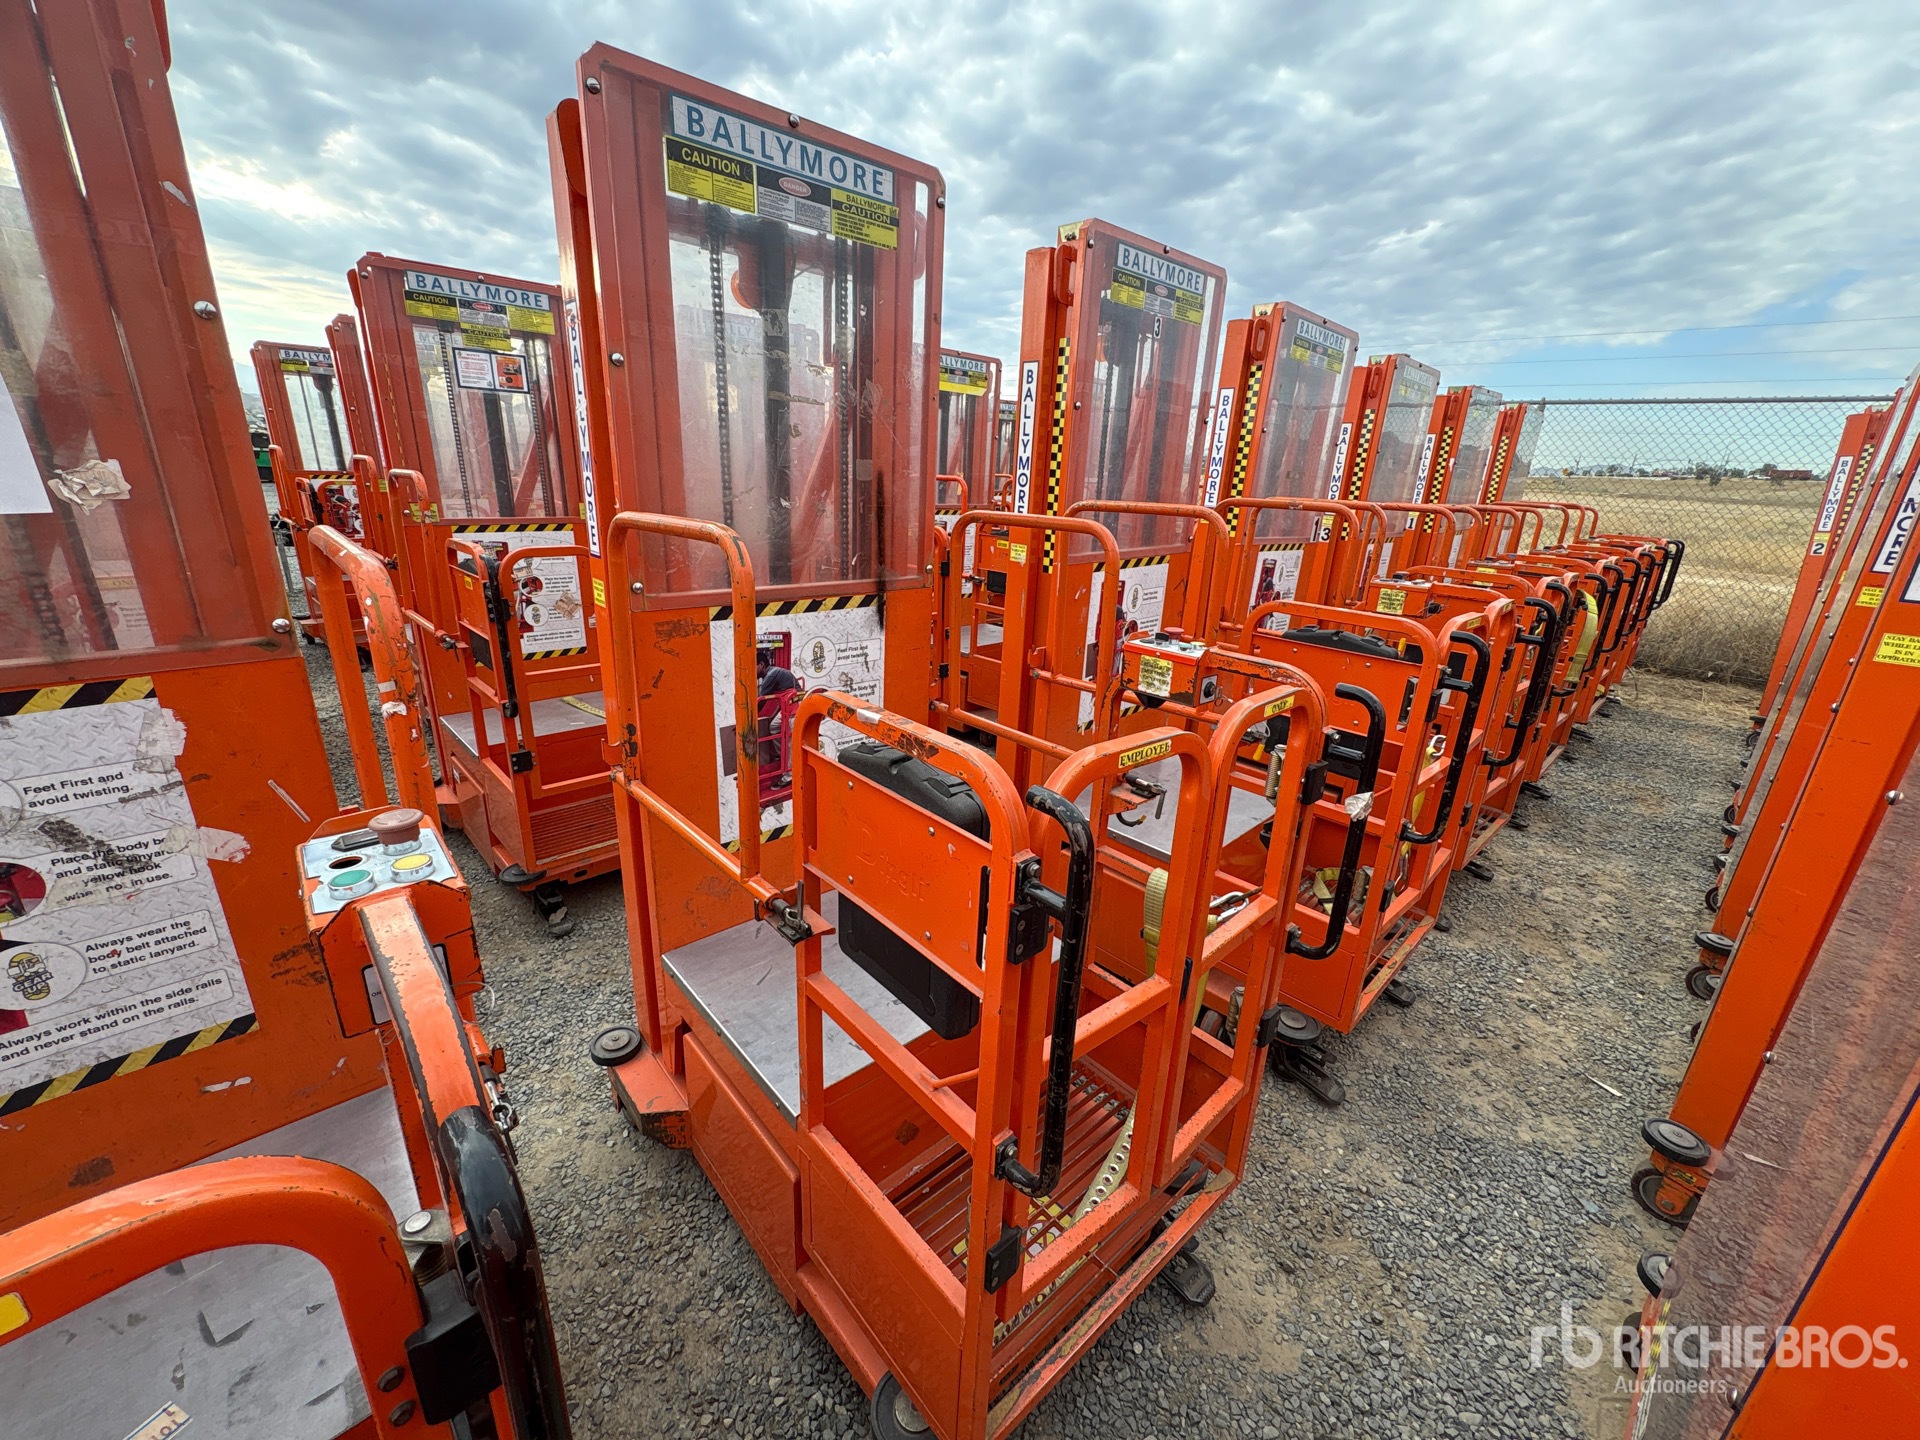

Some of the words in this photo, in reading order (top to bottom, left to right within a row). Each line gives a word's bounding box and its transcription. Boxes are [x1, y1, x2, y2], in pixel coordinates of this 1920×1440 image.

[681, 147, 740, 178] CAUTION
[687, 104, 884, 197] BALLYMORE
[783, 181, 808, 193] DANGER
[842, 203, 890, 224] CAUTION
[846, 194, 887, 213] BALLYMORE
[1123, 247, 1200, 291] BALLYMORE
[413, 292, 449, 305] CAUTION
[415, 274, 543, 308] BALLYMORE
[1154, 318, 1160, 337] 3
[1300, 321, 1344, 350] BALLYMORE
[1208, 395, 1230, 503] BALLYMORE
[1821, 460, 1849, 529] BALLYMORE
[1321, 528, 1330, 541] 3
[1408, 518, 1414, 529] 1
[1813, 543, 1824, 555] 2
[1272, 700, 1288, 714] ONLY
[23, 783, 56, 795] Feet
[60, 778, 94, 790] First
[98, 772, 124, 784] and
[28, 794, 69, 808] avoid
[73, 784, 133, 800] twisting.
[51, 853, 90, 867] Place
[92, 847, 114, 860] the
[116, 840, 150, 854] body
[56, 867, 82, 879] and
[86, 857, 123, 873] static
[82, 870, 126, 888] yellow
[129, 862, 162, 876] hook
[131, 877, 142, 887] in
[146, 873, 173, 884] use.
[85, 934, 133, 953] Always
[136, 926, 167, 939] wear
[170, 919, 191, 930] the
[88, 950, 122, 964] body
[126, 941, 151, 954] belt
[154, 926, 207, 946] attached
[93, 965, 106, 974] to
[110, 954, 146, 970] static
[150, 940, 199, 959] lanyard.
[13, 972, 54, 992] GEAR
[28, 982, 46, 994] UP
[0, 1029, 52, 1050] Always
[55, 1016, 92, 1032] work
[95, 1004, 138, 1021] within
[140, 996, 162, 1008] the
[165, 986, 193, 1000] side
[196, 977, 223, 990] rails
[2, 1048, 30, 1062] and
[34, 1034, 75, 1052] never
[79, 1019, 119, 1038] stand
[122, 1014, 140, 1024] on
[143, 1006, 164, 1018] the
[167, 997, 199, 1010] rails.
